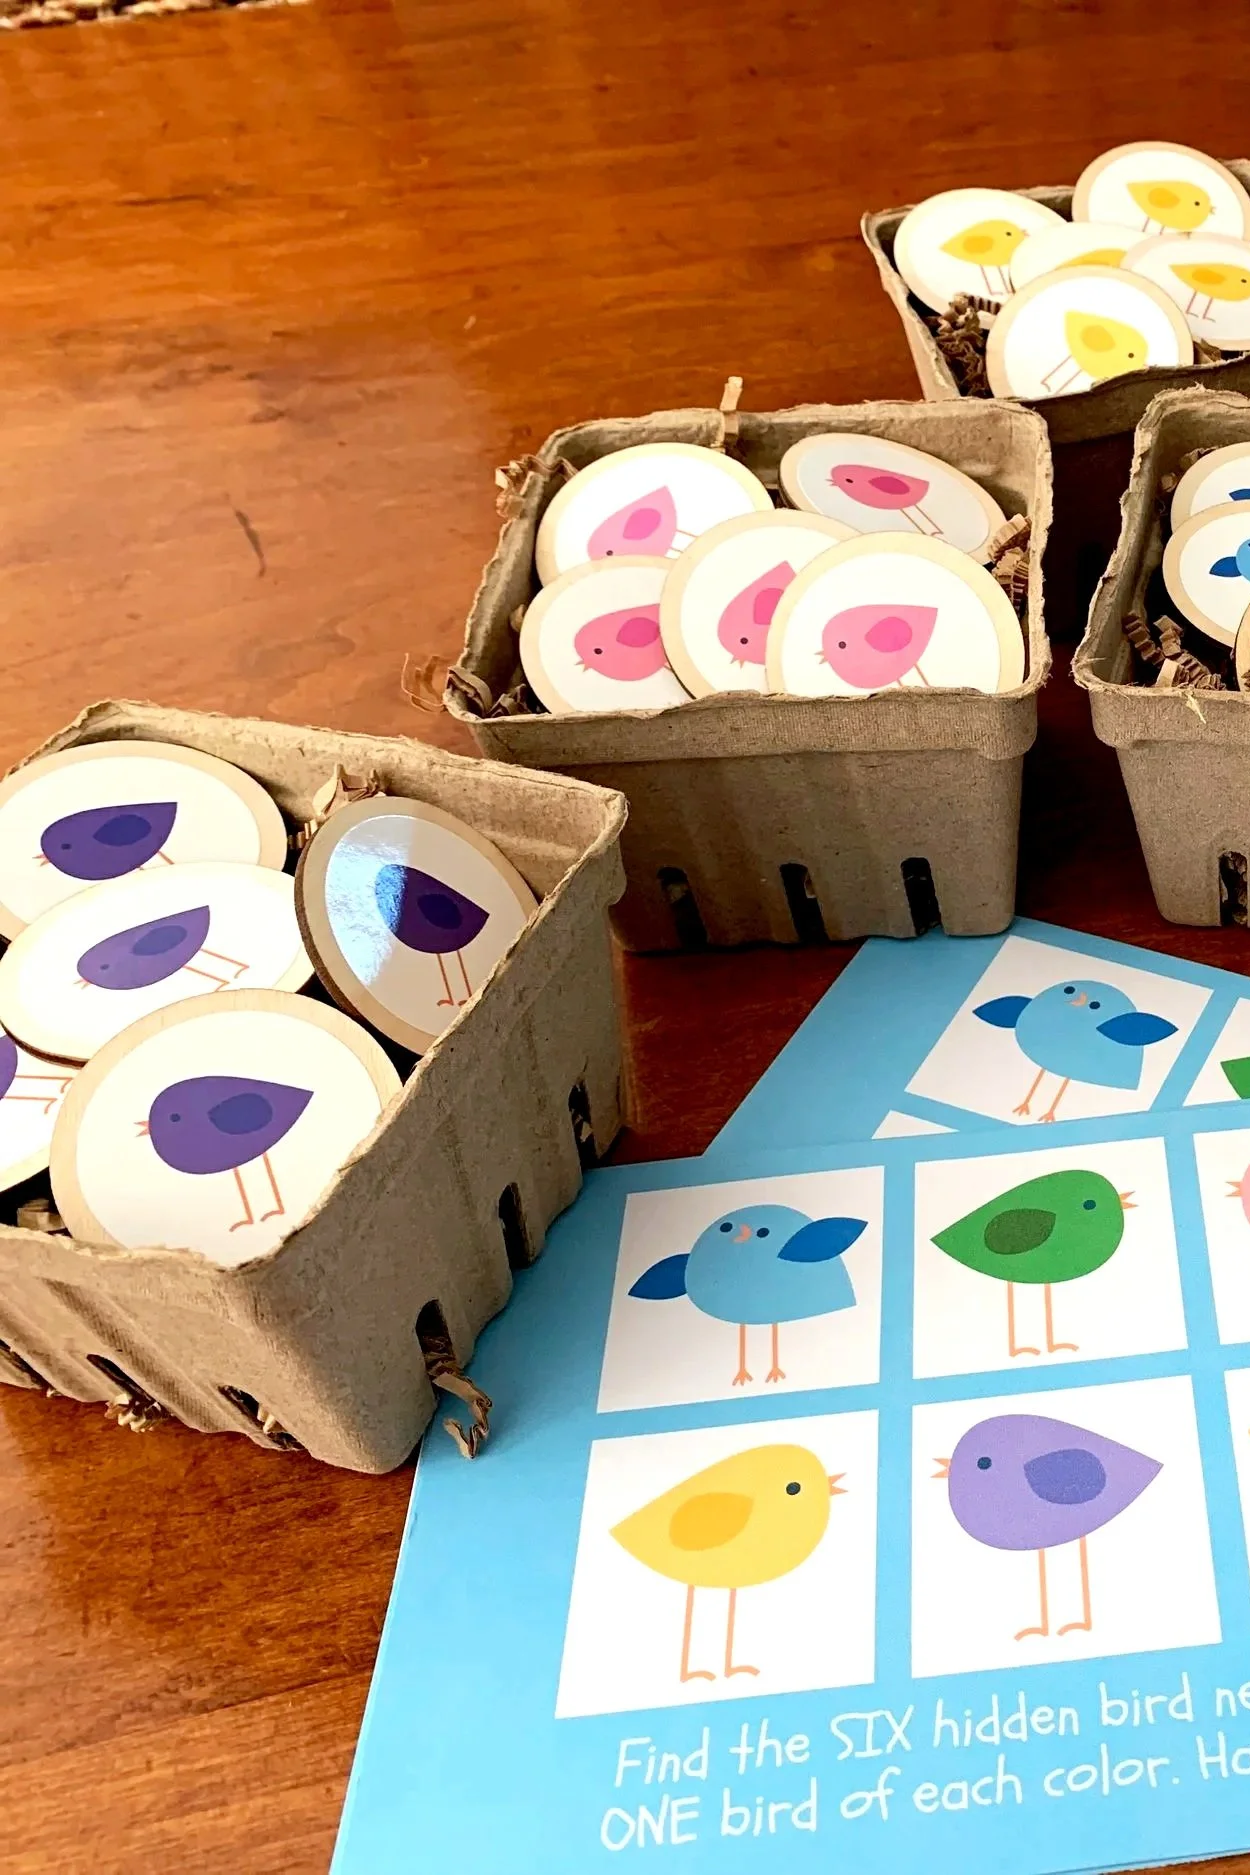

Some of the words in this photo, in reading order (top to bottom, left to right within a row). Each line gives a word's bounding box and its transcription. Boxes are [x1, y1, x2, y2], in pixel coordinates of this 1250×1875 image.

[616, 1727, 709, 1787] Find
[730, 1720, 809, 1773] the
[831, 1705, 913, 1760] SIX
[934, 1692, 1078, 1746] hidden
[1100, 1672, 1193, 1725] bird
[601, 1795, 699, 1850] ONE
[721, 1778, 817, 1836] bird
[841, 1767, 900, 1819] of
[913, 1754, 1022, 1813] each
[1044, 1744, 1178, 1796] color.
